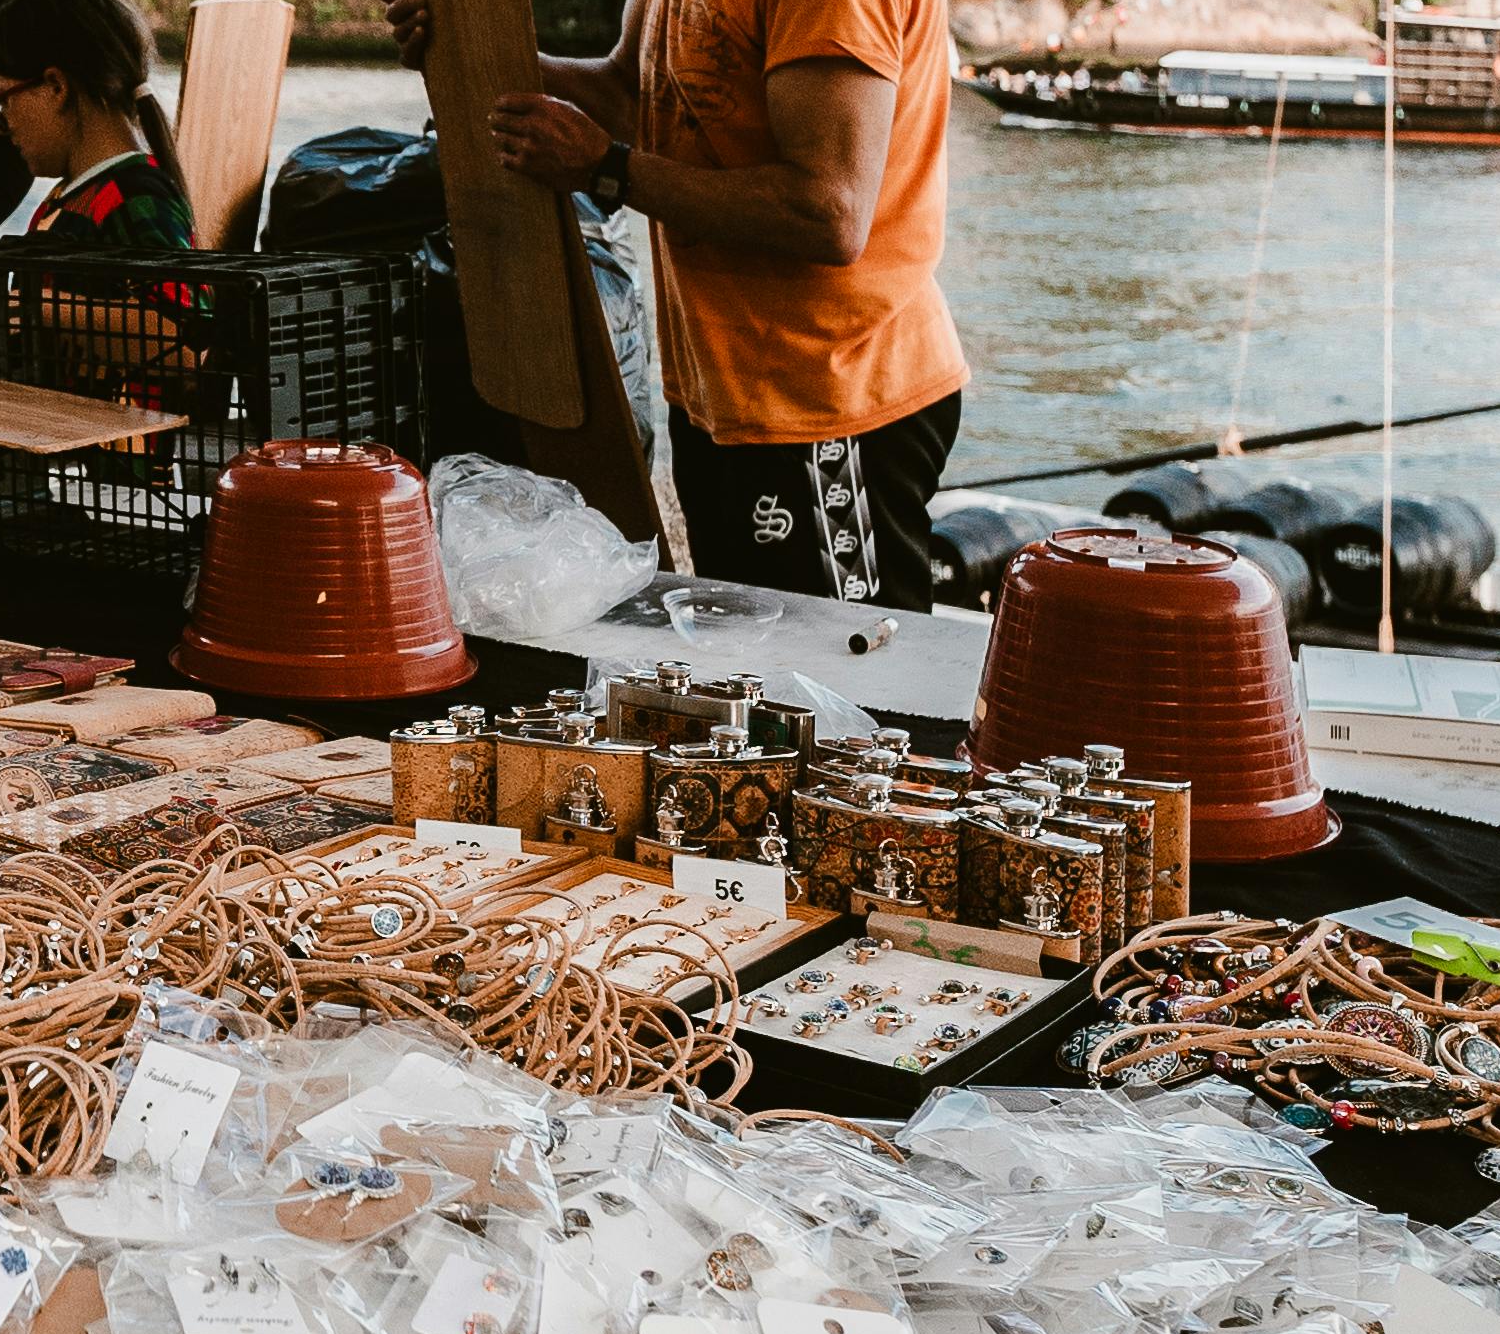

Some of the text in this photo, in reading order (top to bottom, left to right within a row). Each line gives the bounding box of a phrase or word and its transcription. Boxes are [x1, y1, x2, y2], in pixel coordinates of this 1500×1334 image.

[714, 878, 745, 903] 5€
[143, 1067, 217, 1105] Fashion Jewelry
